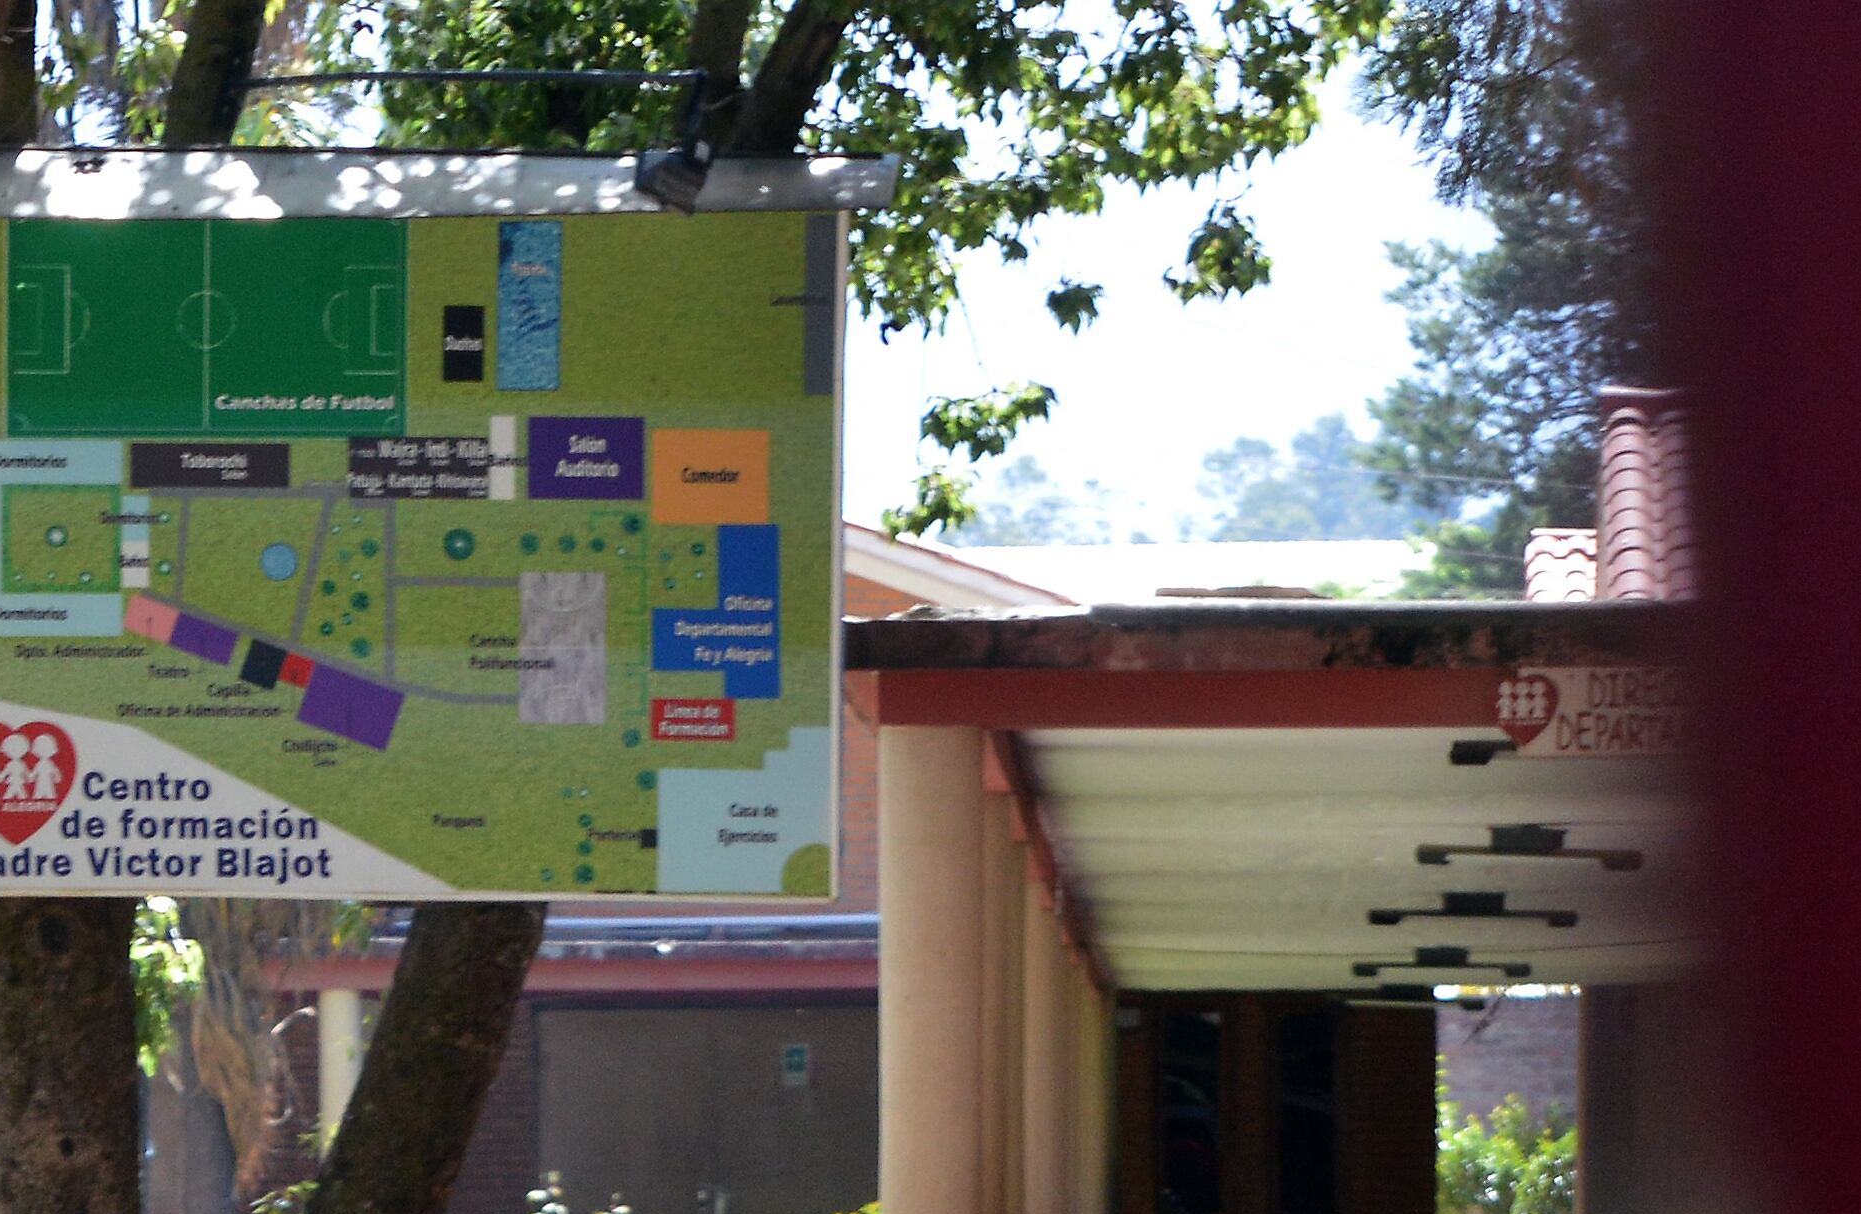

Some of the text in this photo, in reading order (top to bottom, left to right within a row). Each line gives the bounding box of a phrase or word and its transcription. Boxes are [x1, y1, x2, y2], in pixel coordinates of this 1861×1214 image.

[215, 394, 297, 411] Canchas
[300, 394, 327, 410] de
[682, 468, 739, 484] Comedor
[724, 597, 774, 611] Oficina
[674, 621, 773, 638] Departamental
[694, 646, 712, 661] Fe
[83, 772, 211, 801] Centro
[61, 808, 318, 839] de formación
[86, 848, 203, 878] Victor
[217, 848, 331, 884] Blajot
